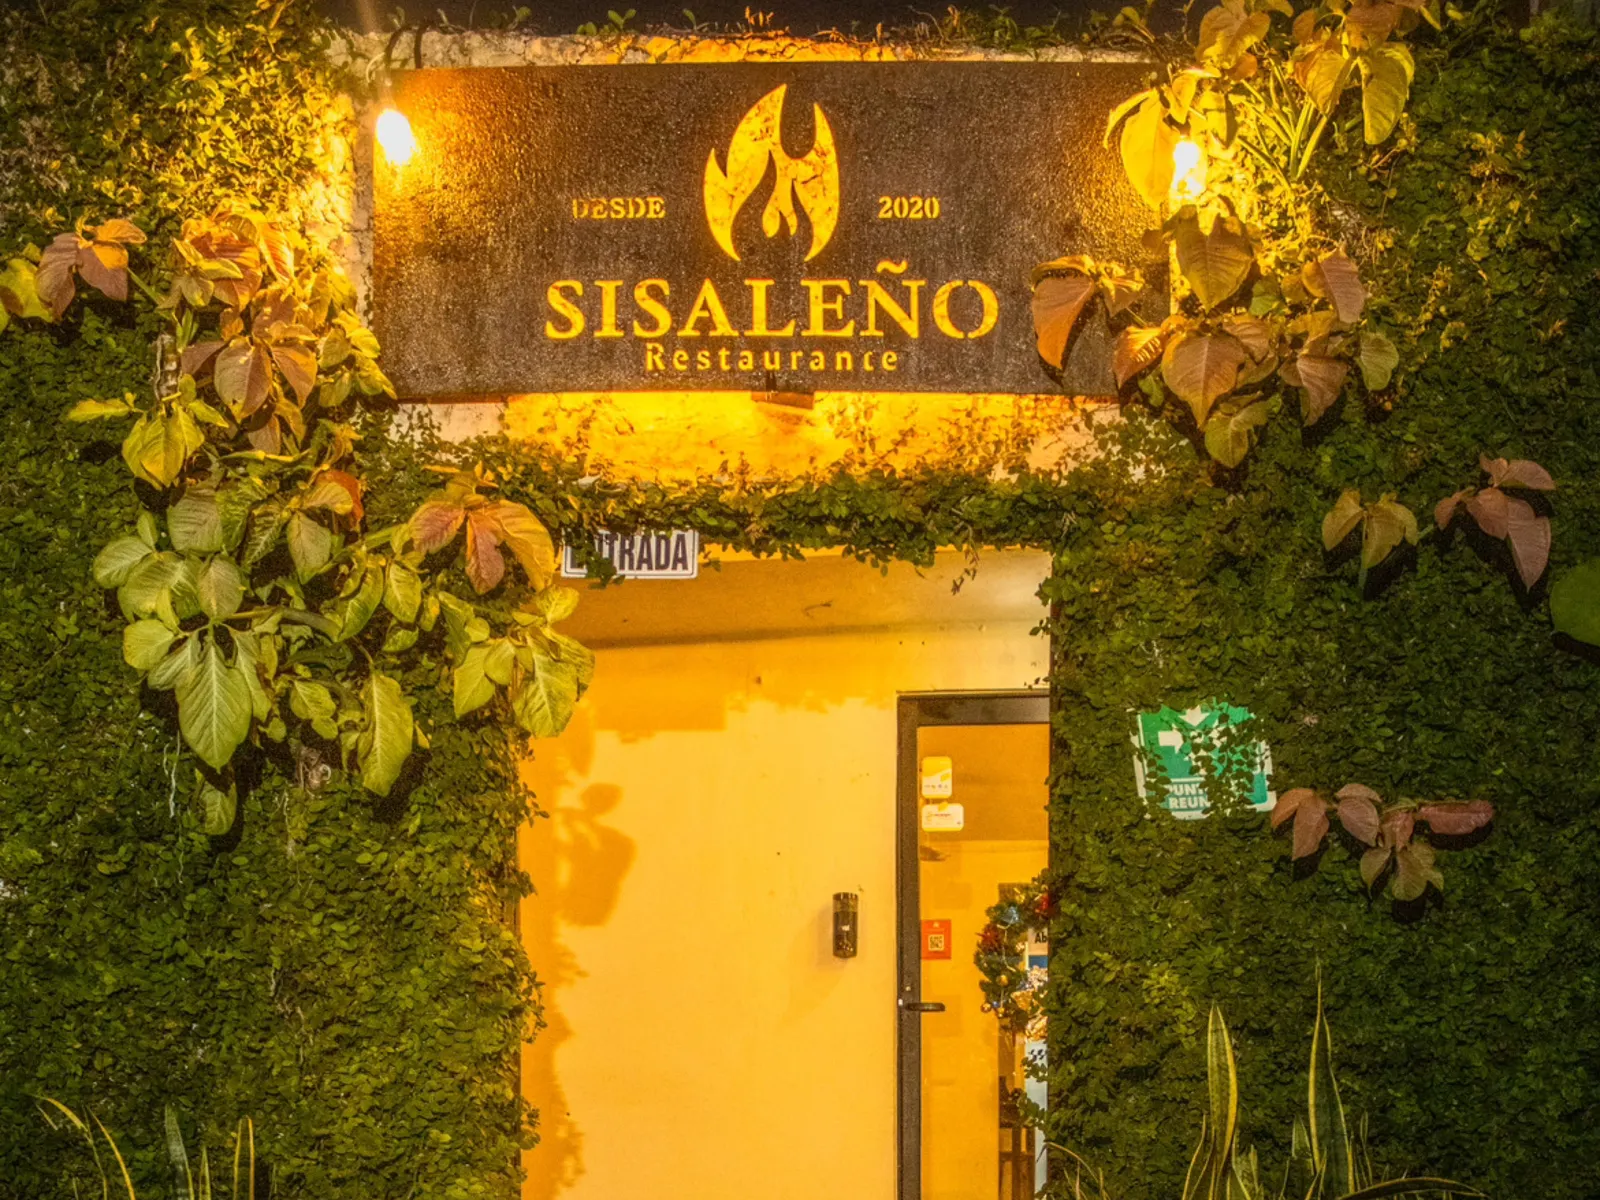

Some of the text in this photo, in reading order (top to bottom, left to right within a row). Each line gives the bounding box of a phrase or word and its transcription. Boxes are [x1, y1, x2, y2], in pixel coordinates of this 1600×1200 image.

[572, 196, 940, 219] DESDE 2020
[544, 260, 999, 339] SISALEÑO
[646, 342, 898, 372] Restaurante
